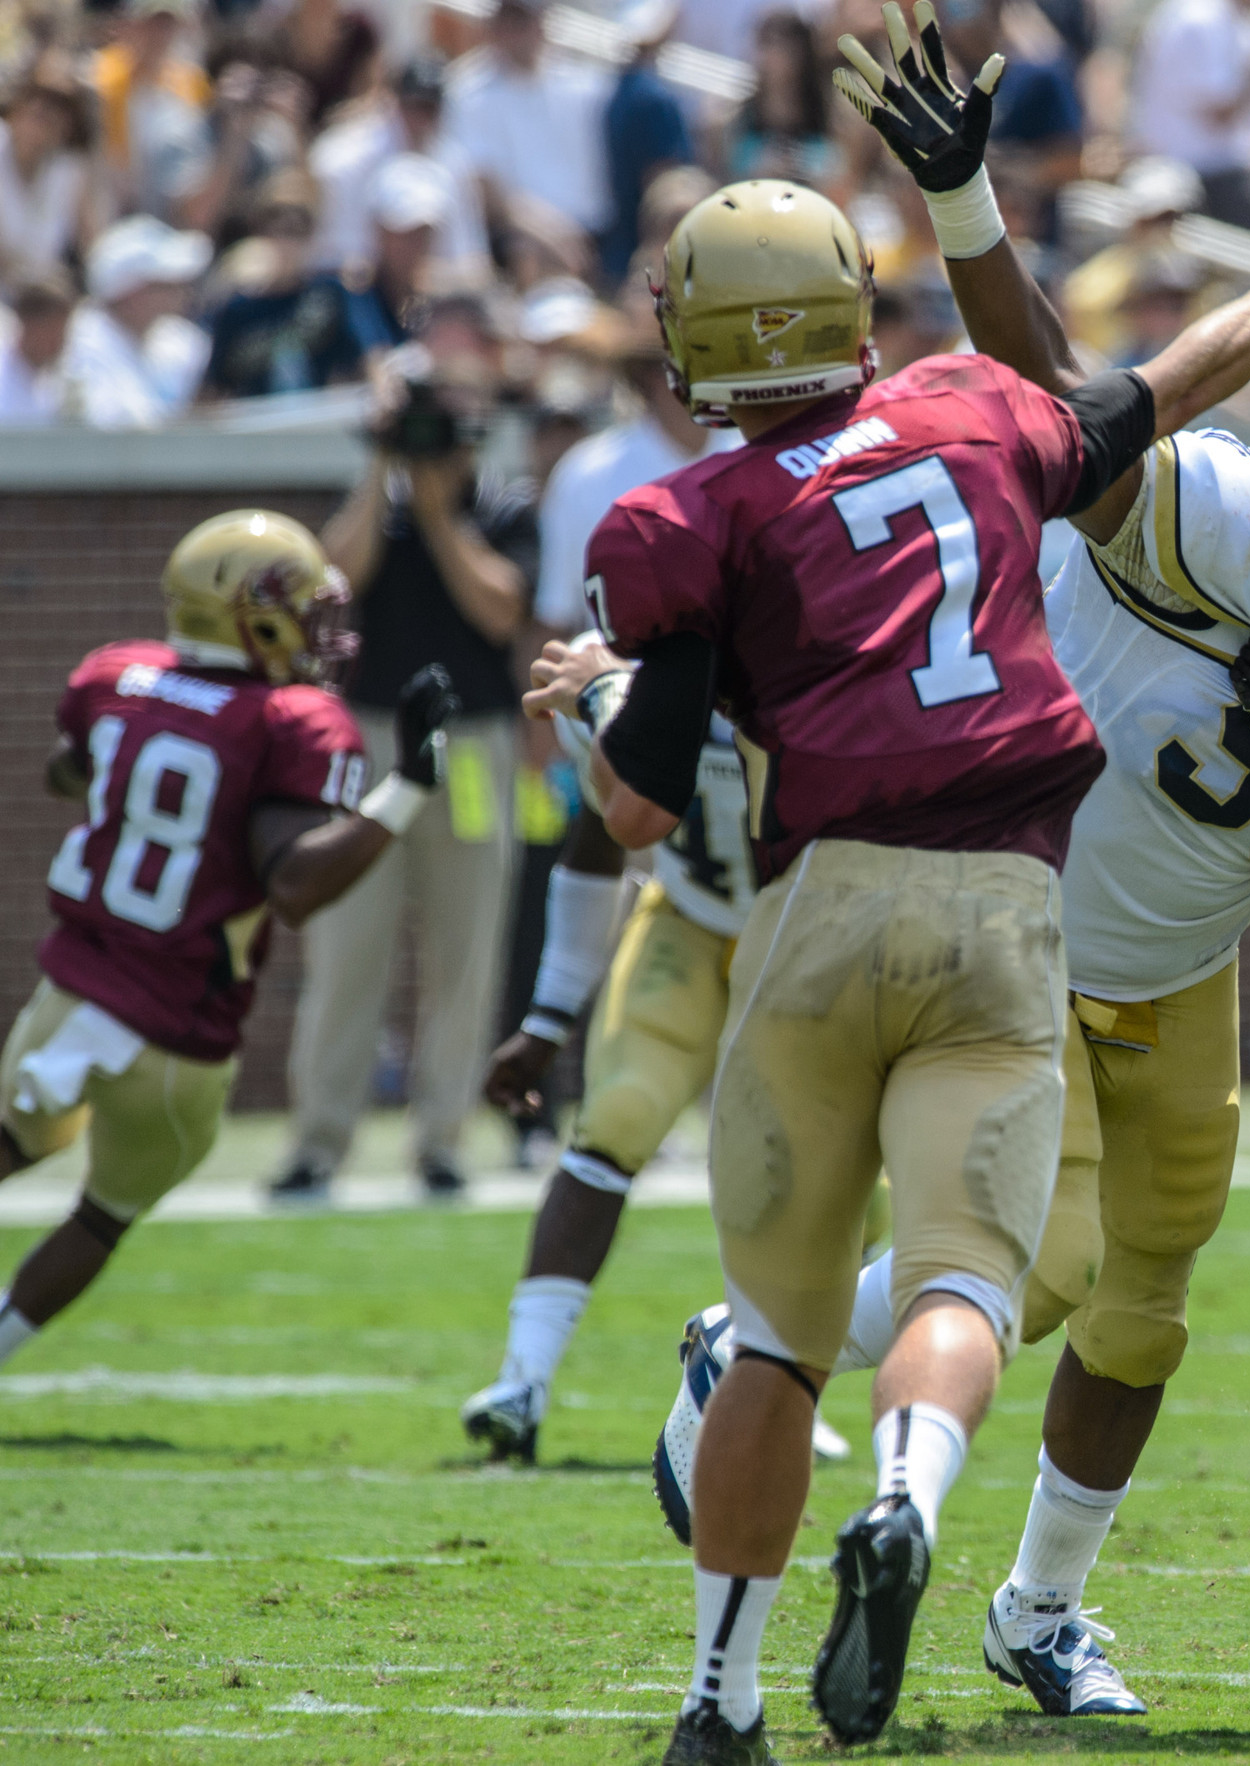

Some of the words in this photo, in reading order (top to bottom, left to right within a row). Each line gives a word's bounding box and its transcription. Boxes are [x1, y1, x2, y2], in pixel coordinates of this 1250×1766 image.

[730, 379, 825, 401] PHOENIX
[832, 452, 1004, 710] 7
[47, 714, 222, 934] 18
[320, 750, 366, 810] 18
